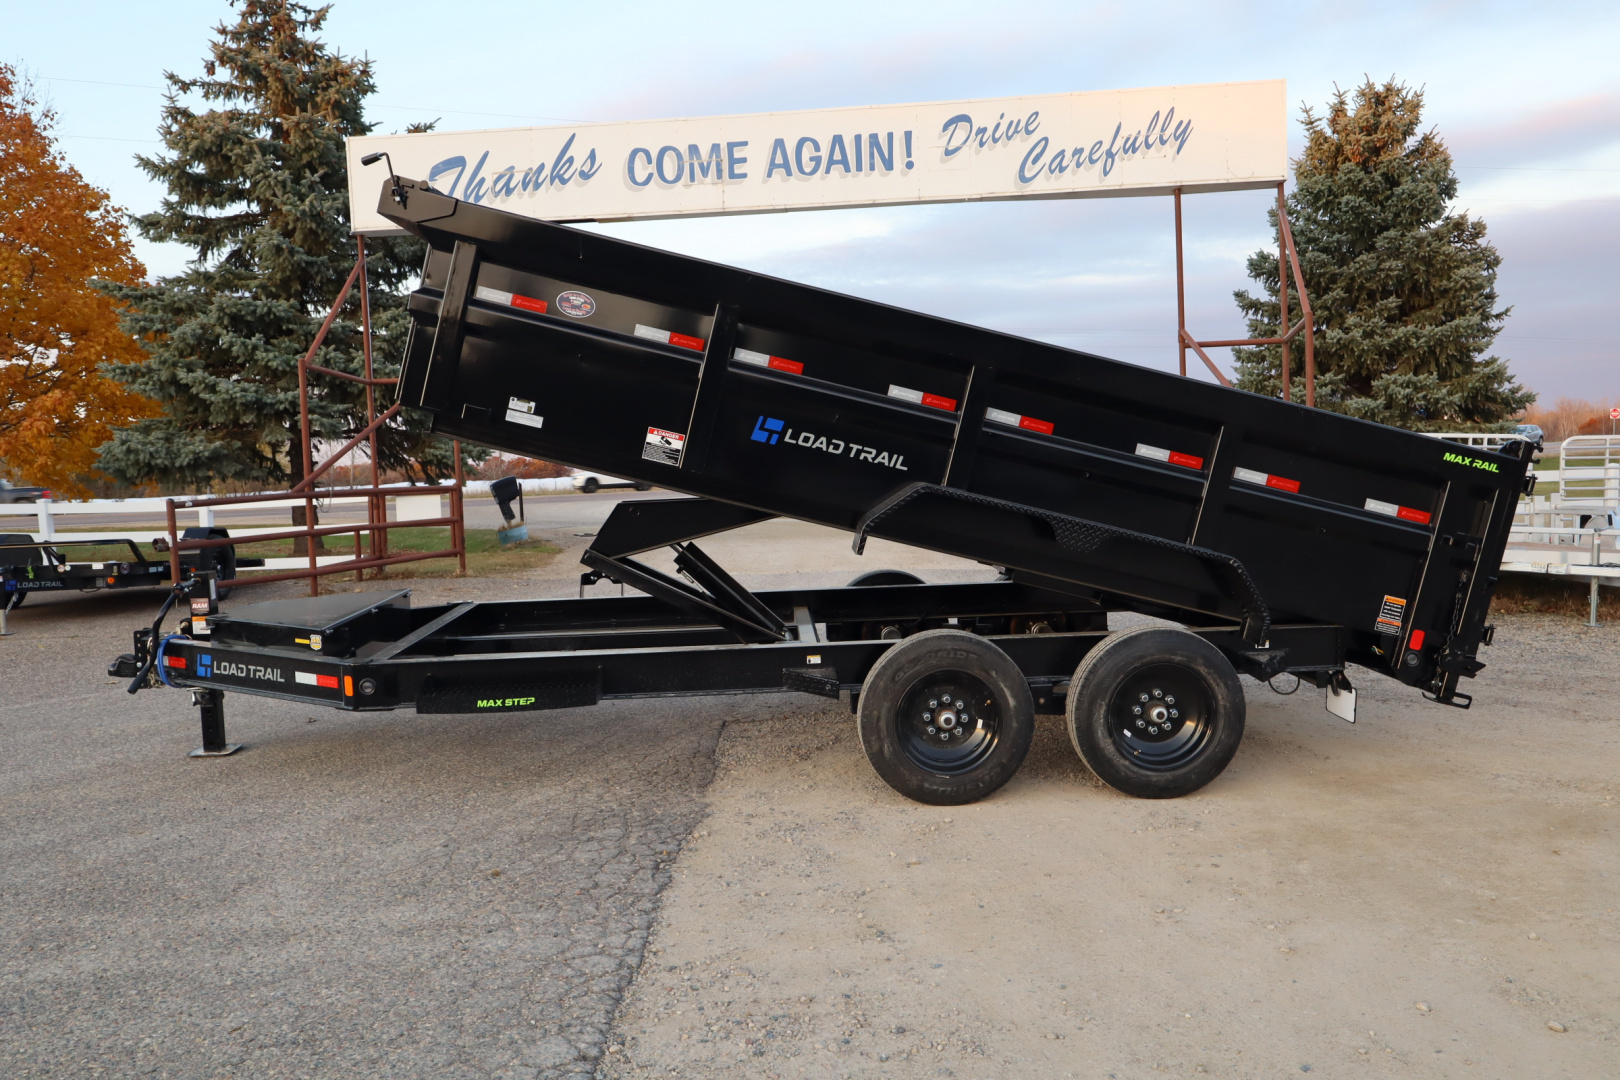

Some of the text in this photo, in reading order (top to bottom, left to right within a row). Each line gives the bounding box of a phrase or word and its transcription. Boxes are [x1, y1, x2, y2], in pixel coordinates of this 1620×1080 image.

[942, 110, 1041, 157] Drive
[1018, 106, 1194, 184] Carefully
[428, 130, 915, 204] Thanks COME AGAIN!
[658, 430, 680, 440] DANGER
[783, 428, 908, 471] LOAD TRAIL
[1443, 452, 1499, 473] MAX RAIL
[41, 580, 63, 588] TRAIL
[213, 660, 285, 683] LOAD TRAIL
[477, 697, 536, 708] MAX STEP
